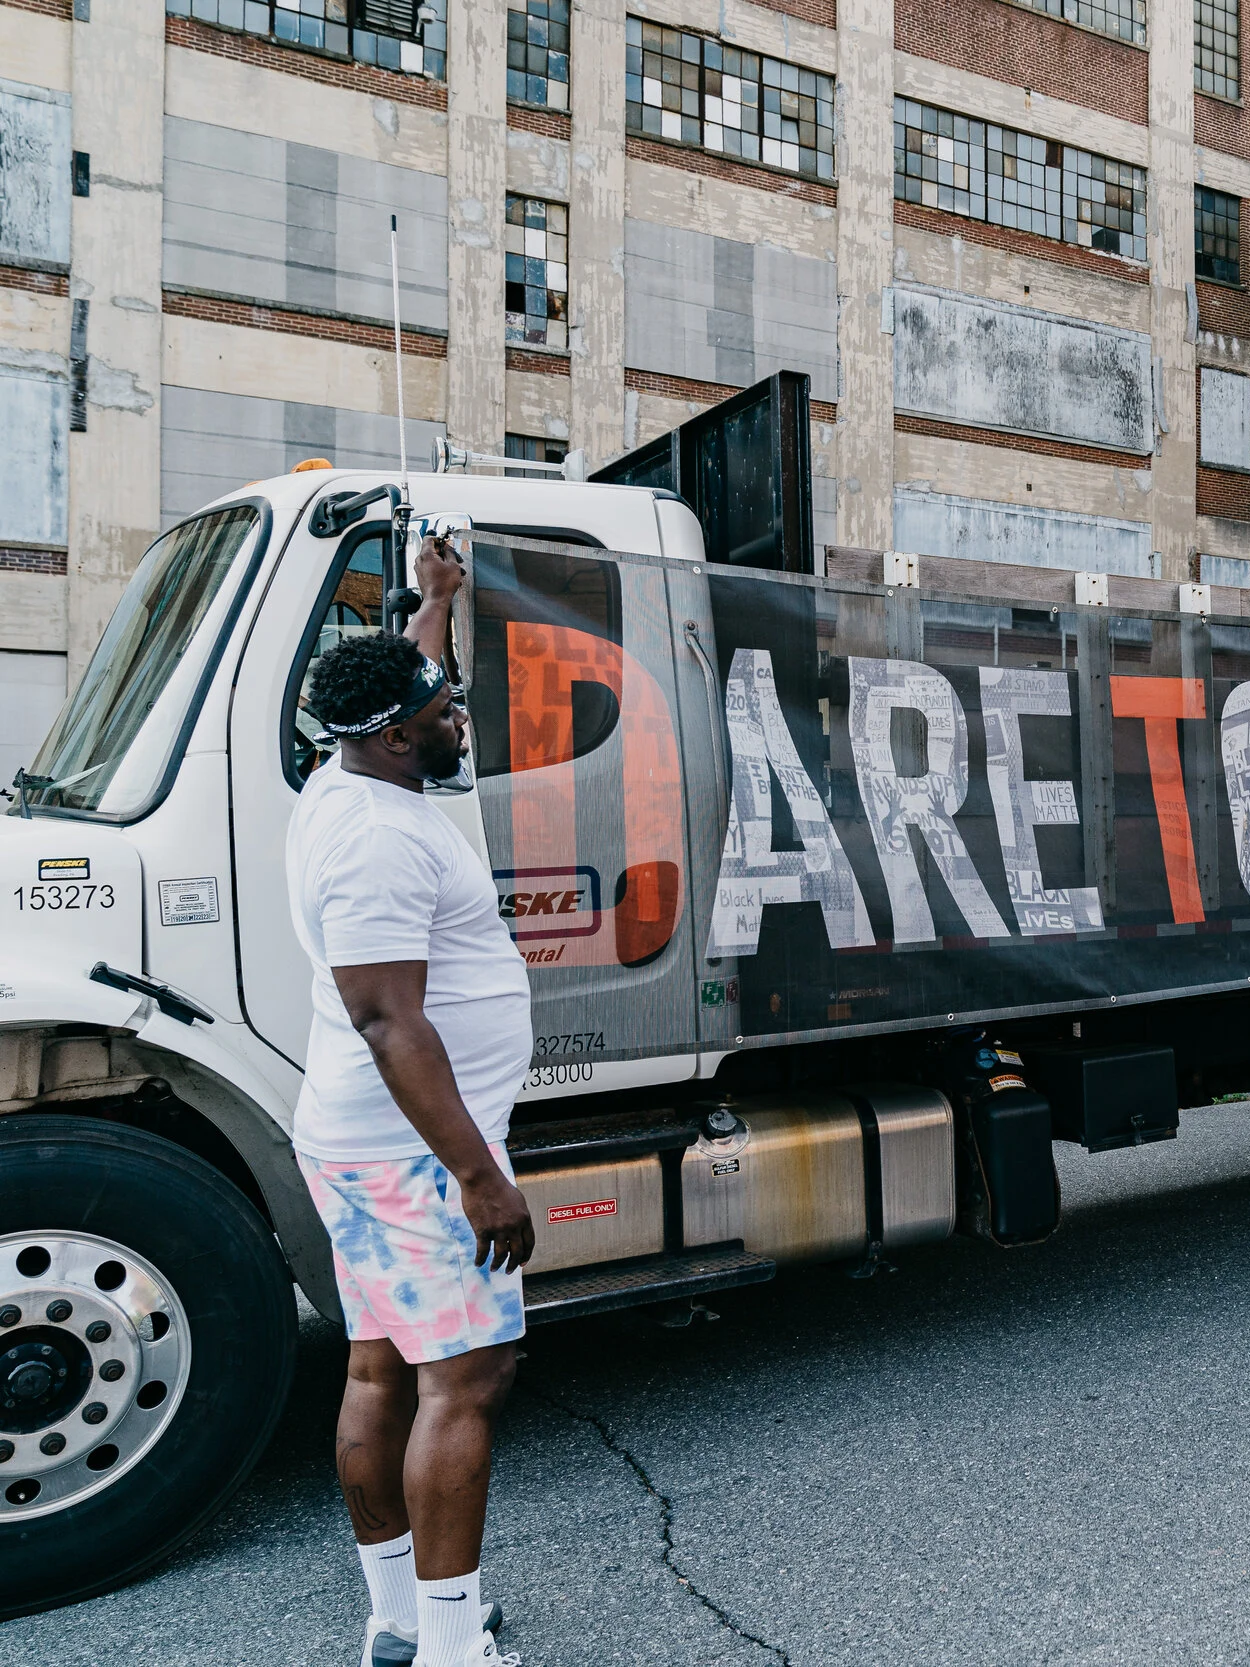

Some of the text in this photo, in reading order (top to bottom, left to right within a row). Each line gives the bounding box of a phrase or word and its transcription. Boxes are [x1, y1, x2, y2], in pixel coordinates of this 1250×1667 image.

[507, 621, 1105, 968] DARE
[873, 776, 954, 804] HANDS UP
[1040, 786, 1073, 804] LIVES
[40, 859, 88, 868] PENSKE
[14, 884, 115, 911] 153273
[498, 889, 586, 918] SKE
[720, 888, 755, 908] Black
[535, 1031, 606, 1057] 327574
[550, 1203, 614, 1219] DIESEL FUEL ONLY
